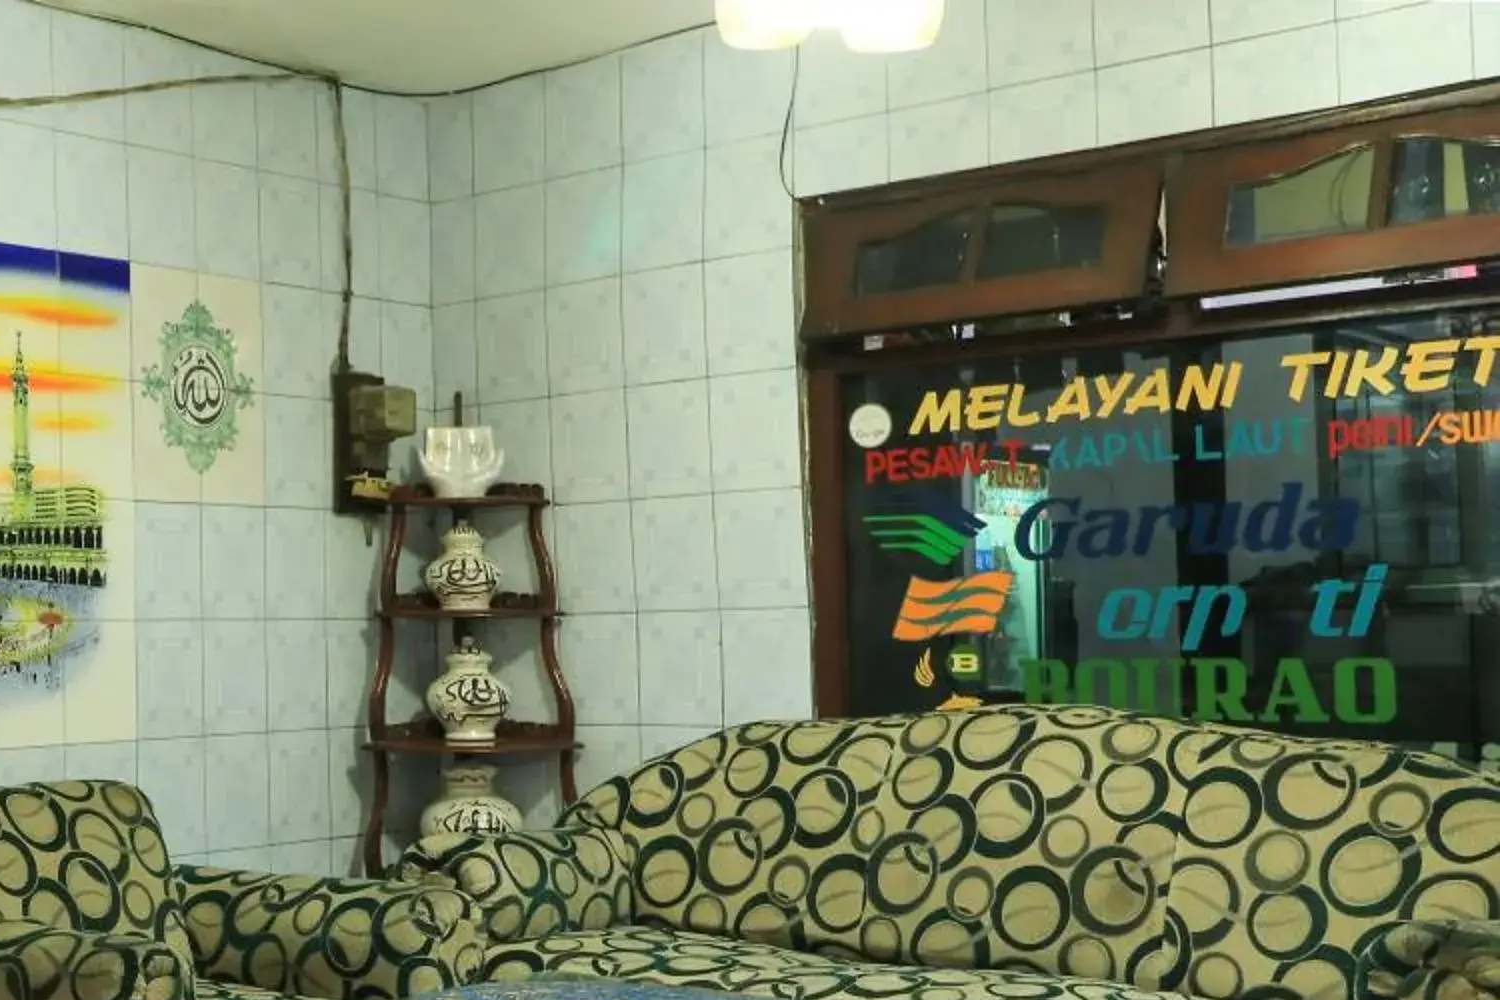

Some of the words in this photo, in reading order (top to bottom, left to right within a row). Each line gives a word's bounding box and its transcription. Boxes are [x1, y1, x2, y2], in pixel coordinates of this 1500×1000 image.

[908, 362, 1243, 436] MELAYANI
[1281, 335, 1500, 404] TIKET
[1014, 481, 1364, 561] Garuda
